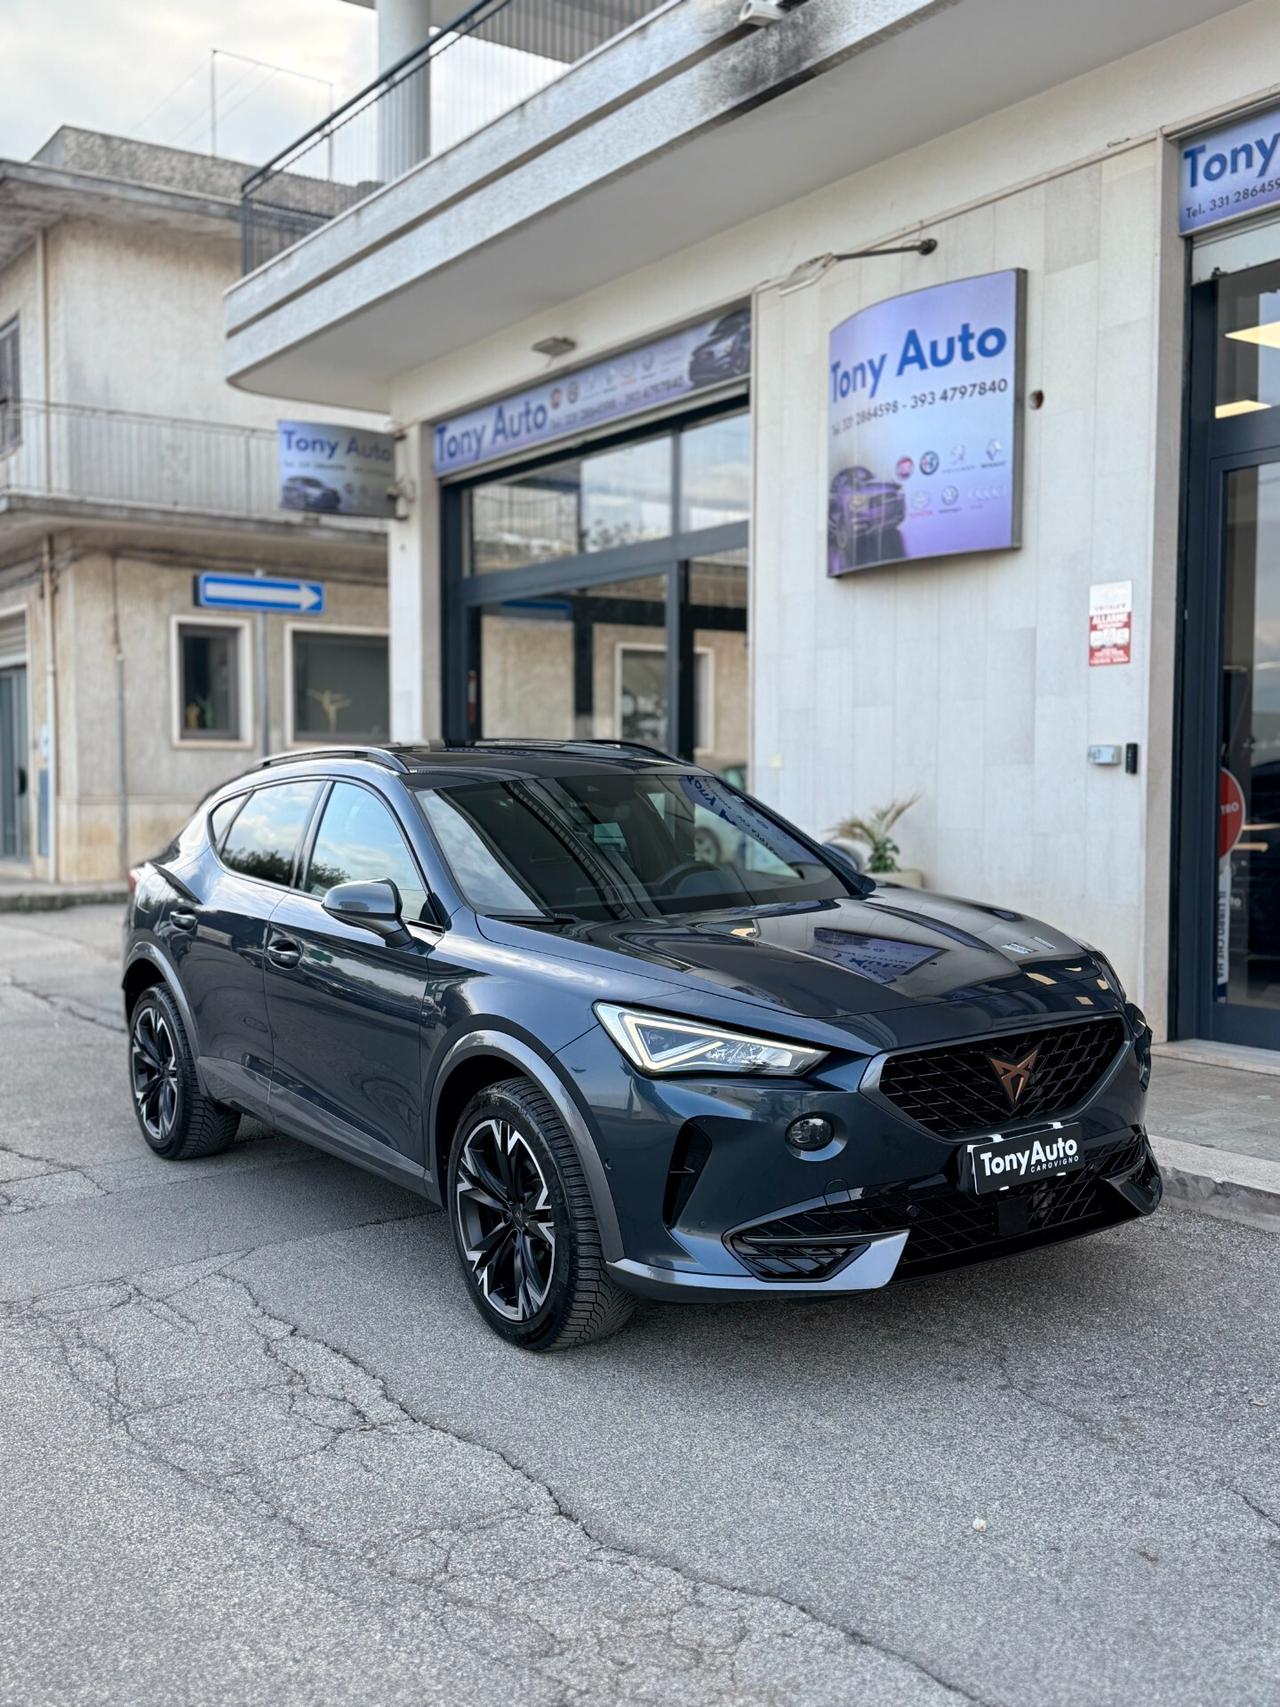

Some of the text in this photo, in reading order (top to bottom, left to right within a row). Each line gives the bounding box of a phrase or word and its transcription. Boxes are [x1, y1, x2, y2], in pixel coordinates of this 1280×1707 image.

[1184, 132, 1280, 188] Tony
[1186, 203, 1206, 218] Tel.
[1209, 195, 1230, 212] 331
[830, 323, 1007, 403] Tony Auto
[911, 391, 936, 409] 393
[939, 378, 1008, 402] 4797840
[283, 430, 391, 462] Tony Auto
[435, 418, 487, 463] Tony
[491, 401, 548, 446] Auto
[980, 1137, 1078, 1176] TonyAuto
[1031, 1155, 1079, 1173] CAROVIGNO
